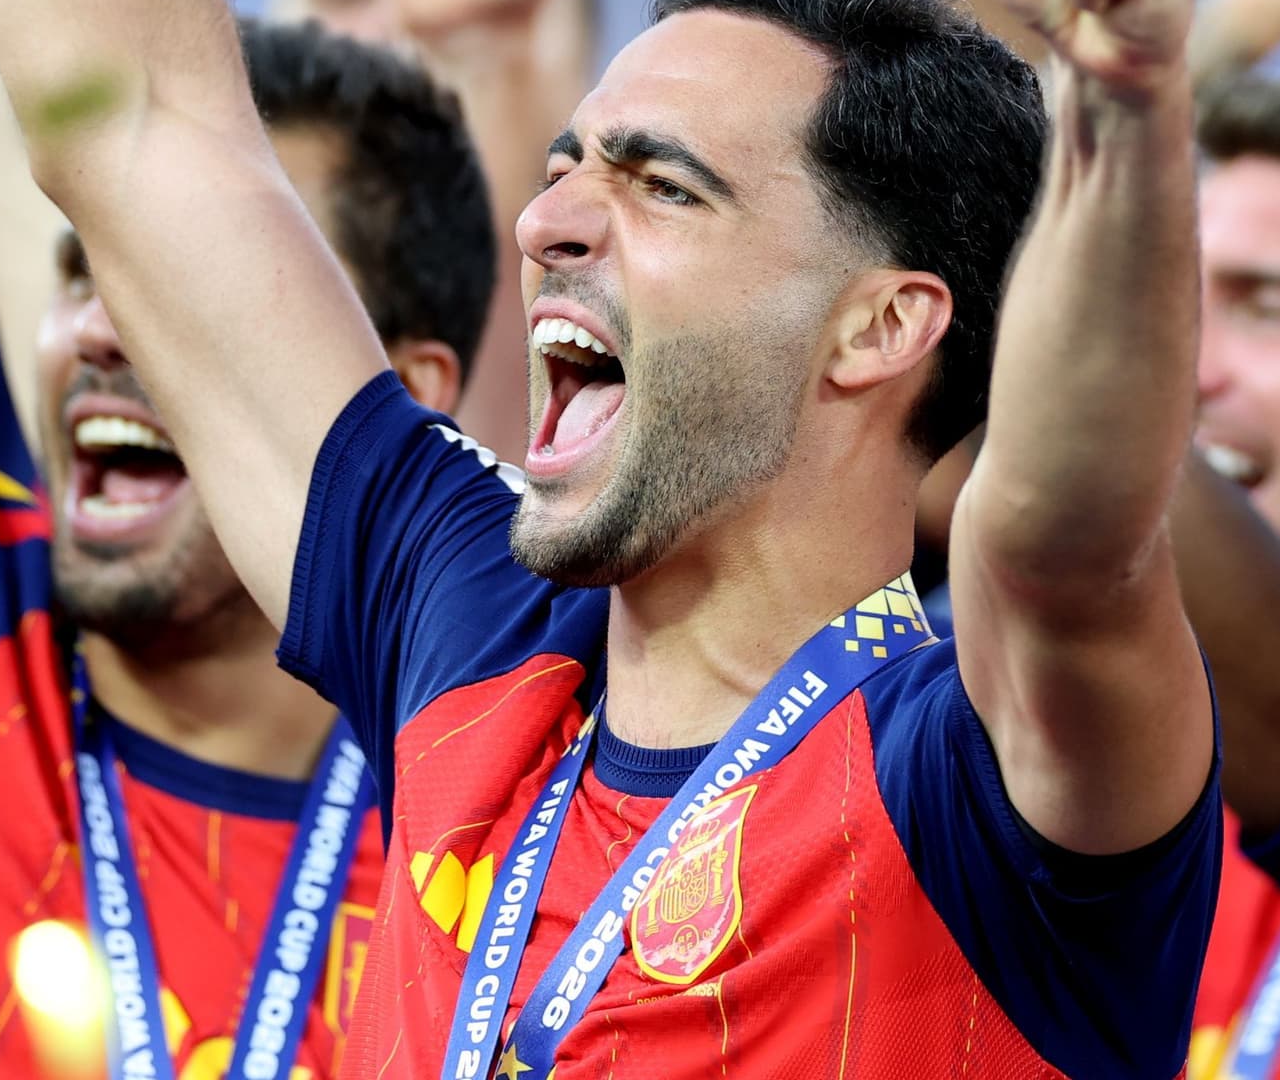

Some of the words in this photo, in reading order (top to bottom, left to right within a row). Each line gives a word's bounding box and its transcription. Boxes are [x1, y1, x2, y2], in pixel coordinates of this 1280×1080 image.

[756, 670, 828, 736] FIFA
[523, 778, 569, 845] FIFA
[293, 804, 351, 911] WORLD
[95, 859, 132, 928] CUP
[485, 846, 541, 970] WORLD
[276, 908, 319, 973] CUP
[542, 910, 625, 1030] 2026
[104, 928, 151, 1052] WORLD
[466, 973, 501, 1044] CUP
